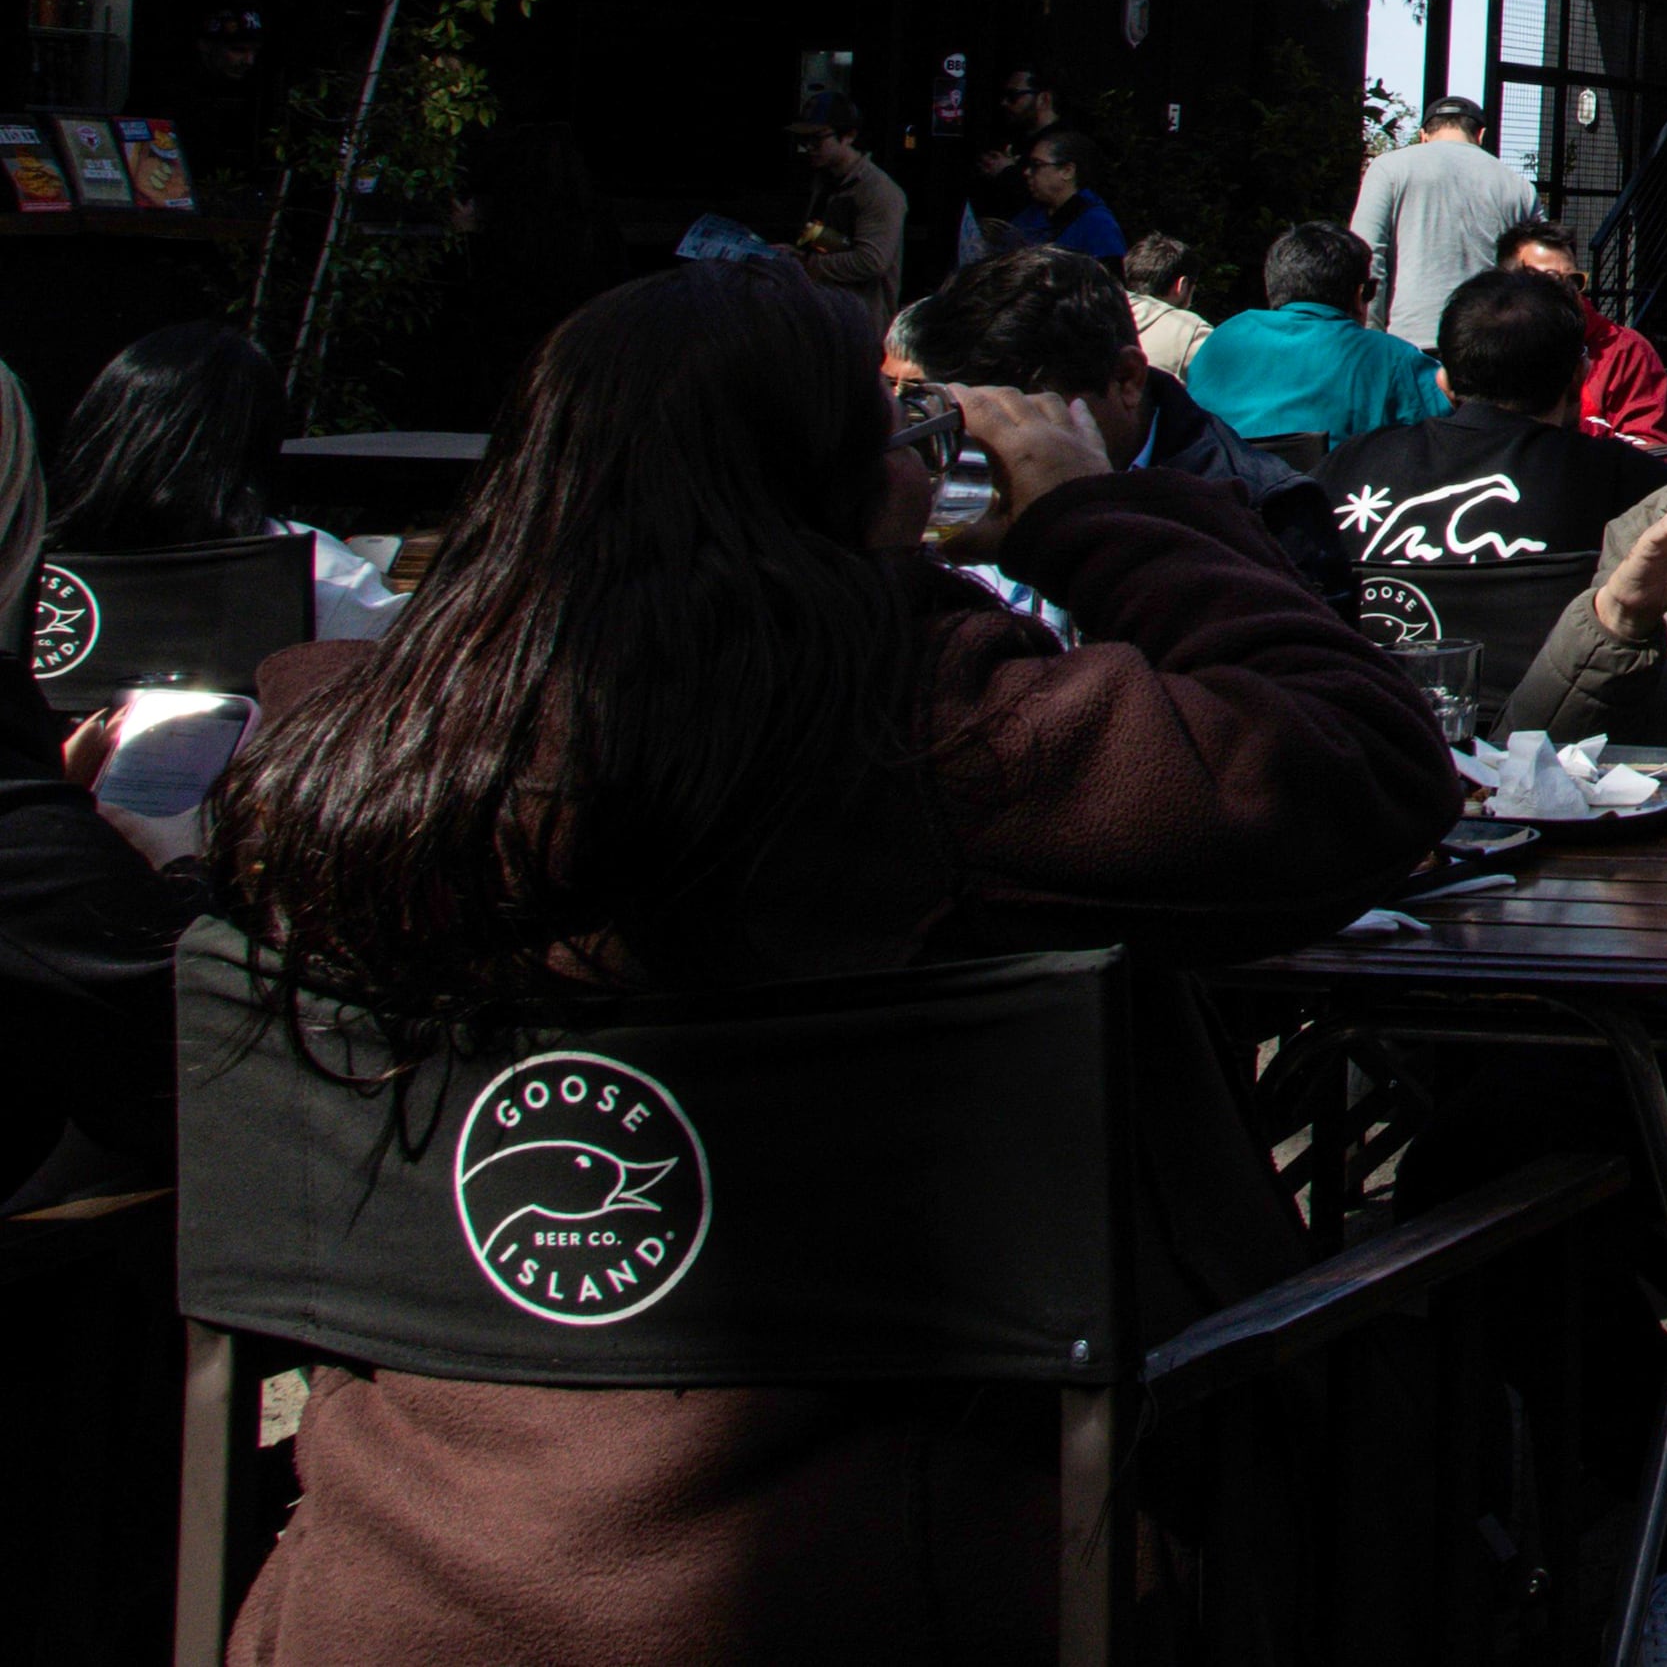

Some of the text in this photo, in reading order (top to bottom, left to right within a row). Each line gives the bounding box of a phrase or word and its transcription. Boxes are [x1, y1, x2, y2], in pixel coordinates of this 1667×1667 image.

[1361, 585, 1418, 613] OOSE
[496, 1075, 653, 1133] GOOSE
[533, 1231, 623, 1247] BEER CO.
[499, 1236, 667, 1303] ISLAND
